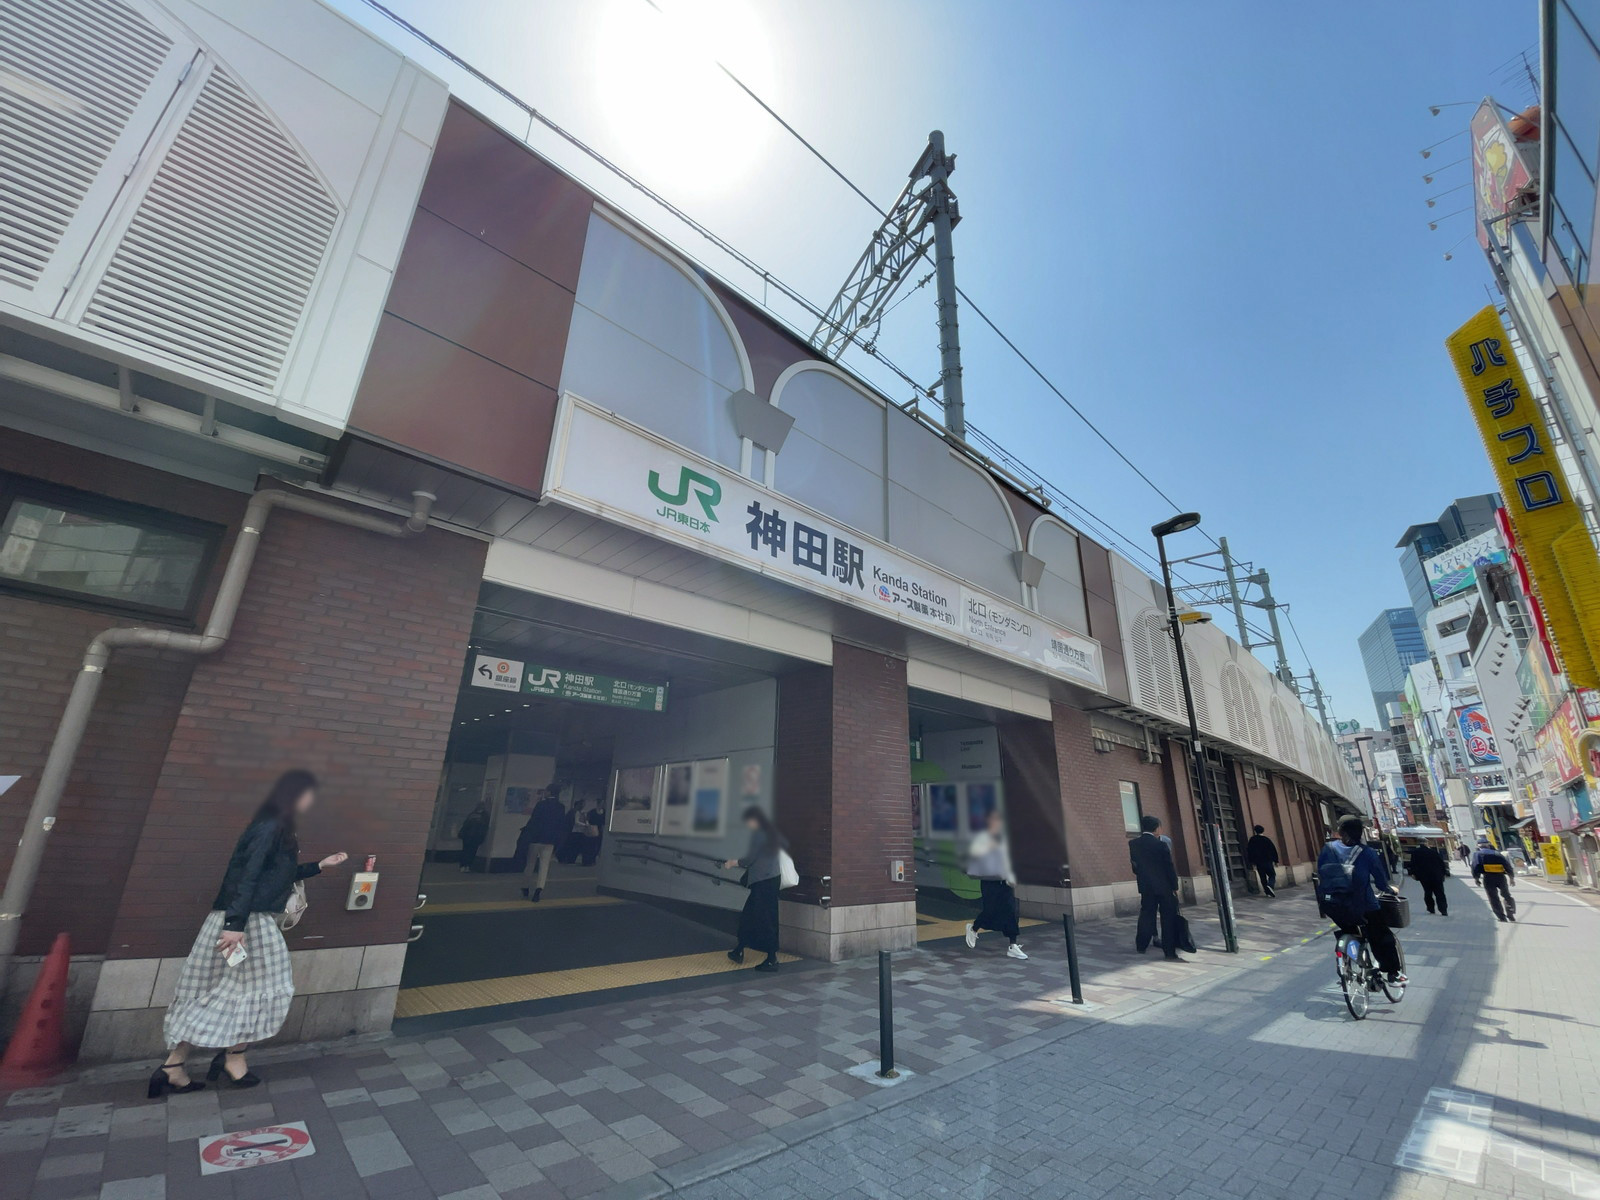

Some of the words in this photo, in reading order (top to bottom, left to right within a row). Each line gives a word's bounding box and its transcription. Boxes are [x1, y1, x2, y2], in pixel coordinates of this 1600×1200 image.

[1469, 338, 1562, 512] パチスロ
[648, 466, 721, 523] JR
[656, 506, 711, 533] JR東日本
[746, 500, 865, 591] 神田駅
[1444, 541, 1493, 570] アドバンス
[873, 565, 909, 592] Kanda
[911, 582, 947, 607] Station
[528, 668, 561, 689] JR
[563, 684, 582, 692] Kanda
[583, 686, 602, 694] Station
[565, 672, 595, 686] 神田駅
